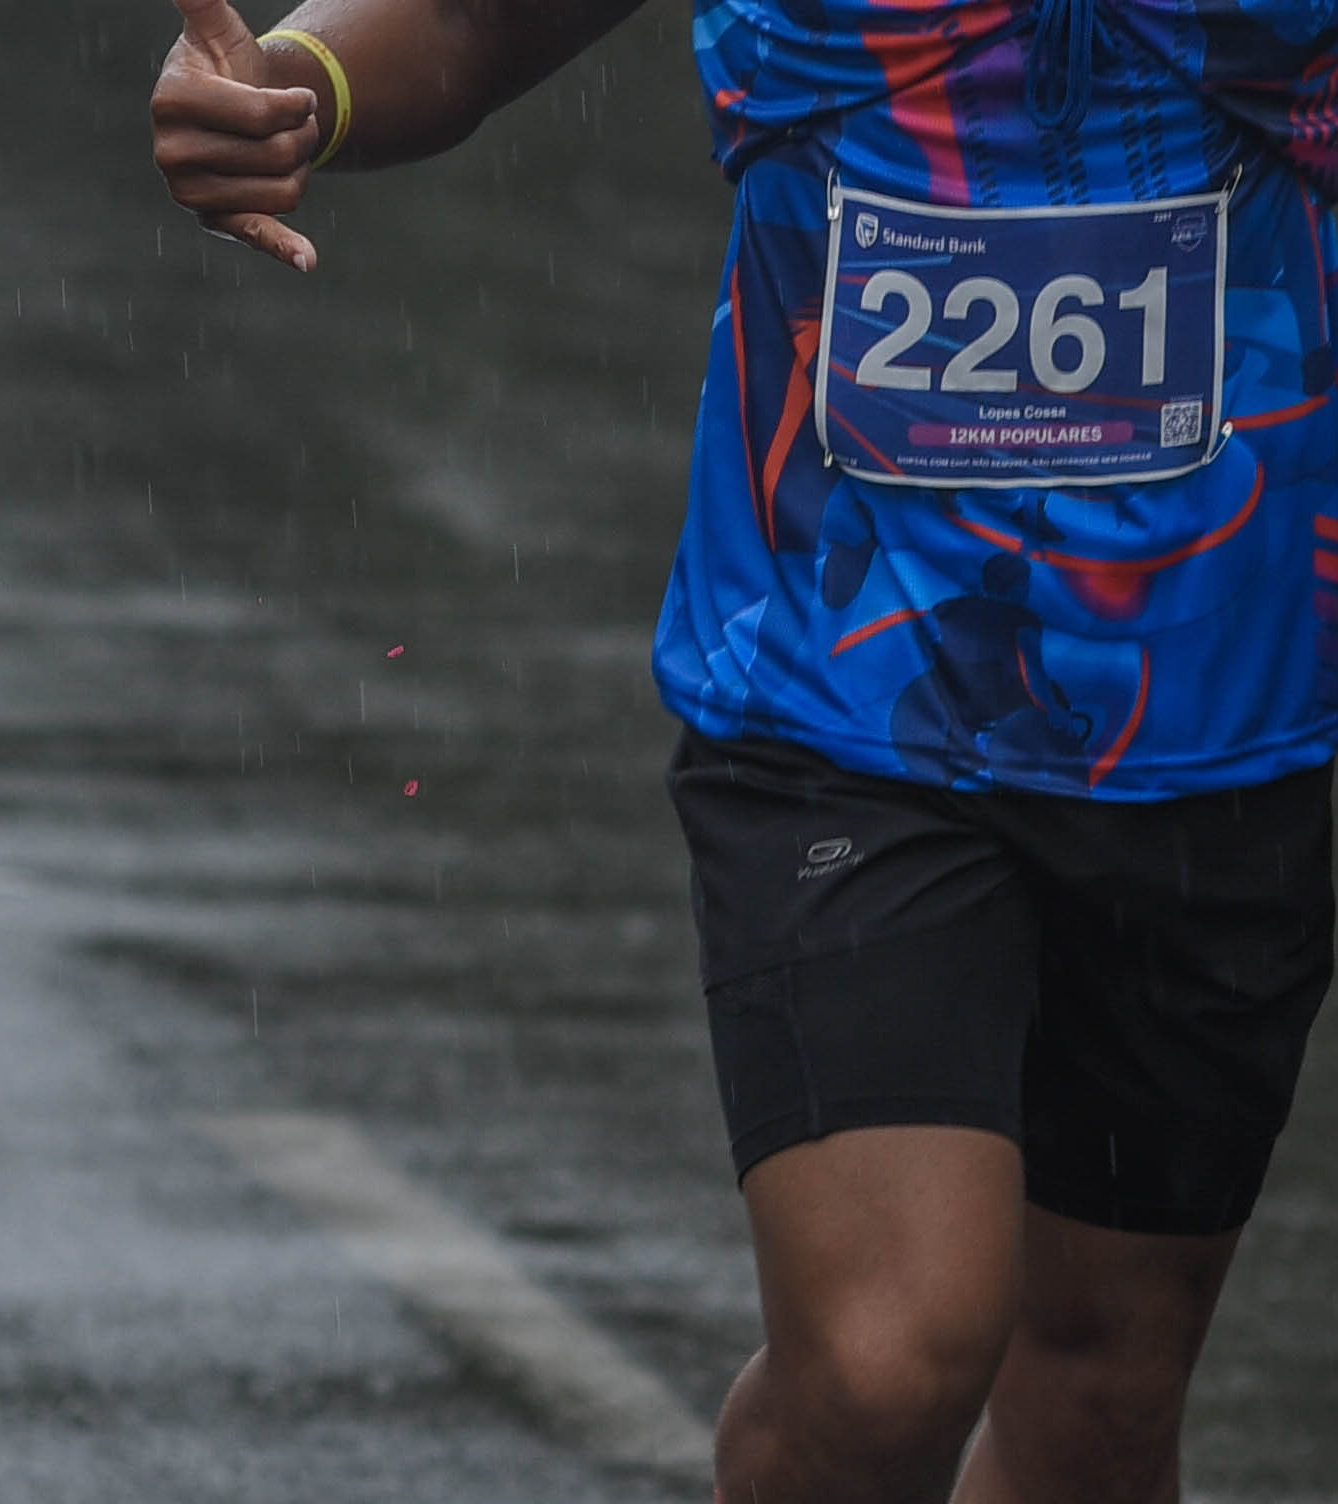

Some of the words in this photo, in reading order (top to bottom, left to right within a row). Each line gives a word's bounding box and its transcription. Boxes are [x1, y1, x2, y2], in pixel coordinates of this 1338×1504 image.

[882, 226, 945, 252] Standard
[948, 236, 986, 254] Bank
[855, 266, 1168, 394] 2261
[979, 405, 1021, 421] Lopes
[949, 427, 995, 444] 12KM
[999, 425, 1103, 444] POPULARES
